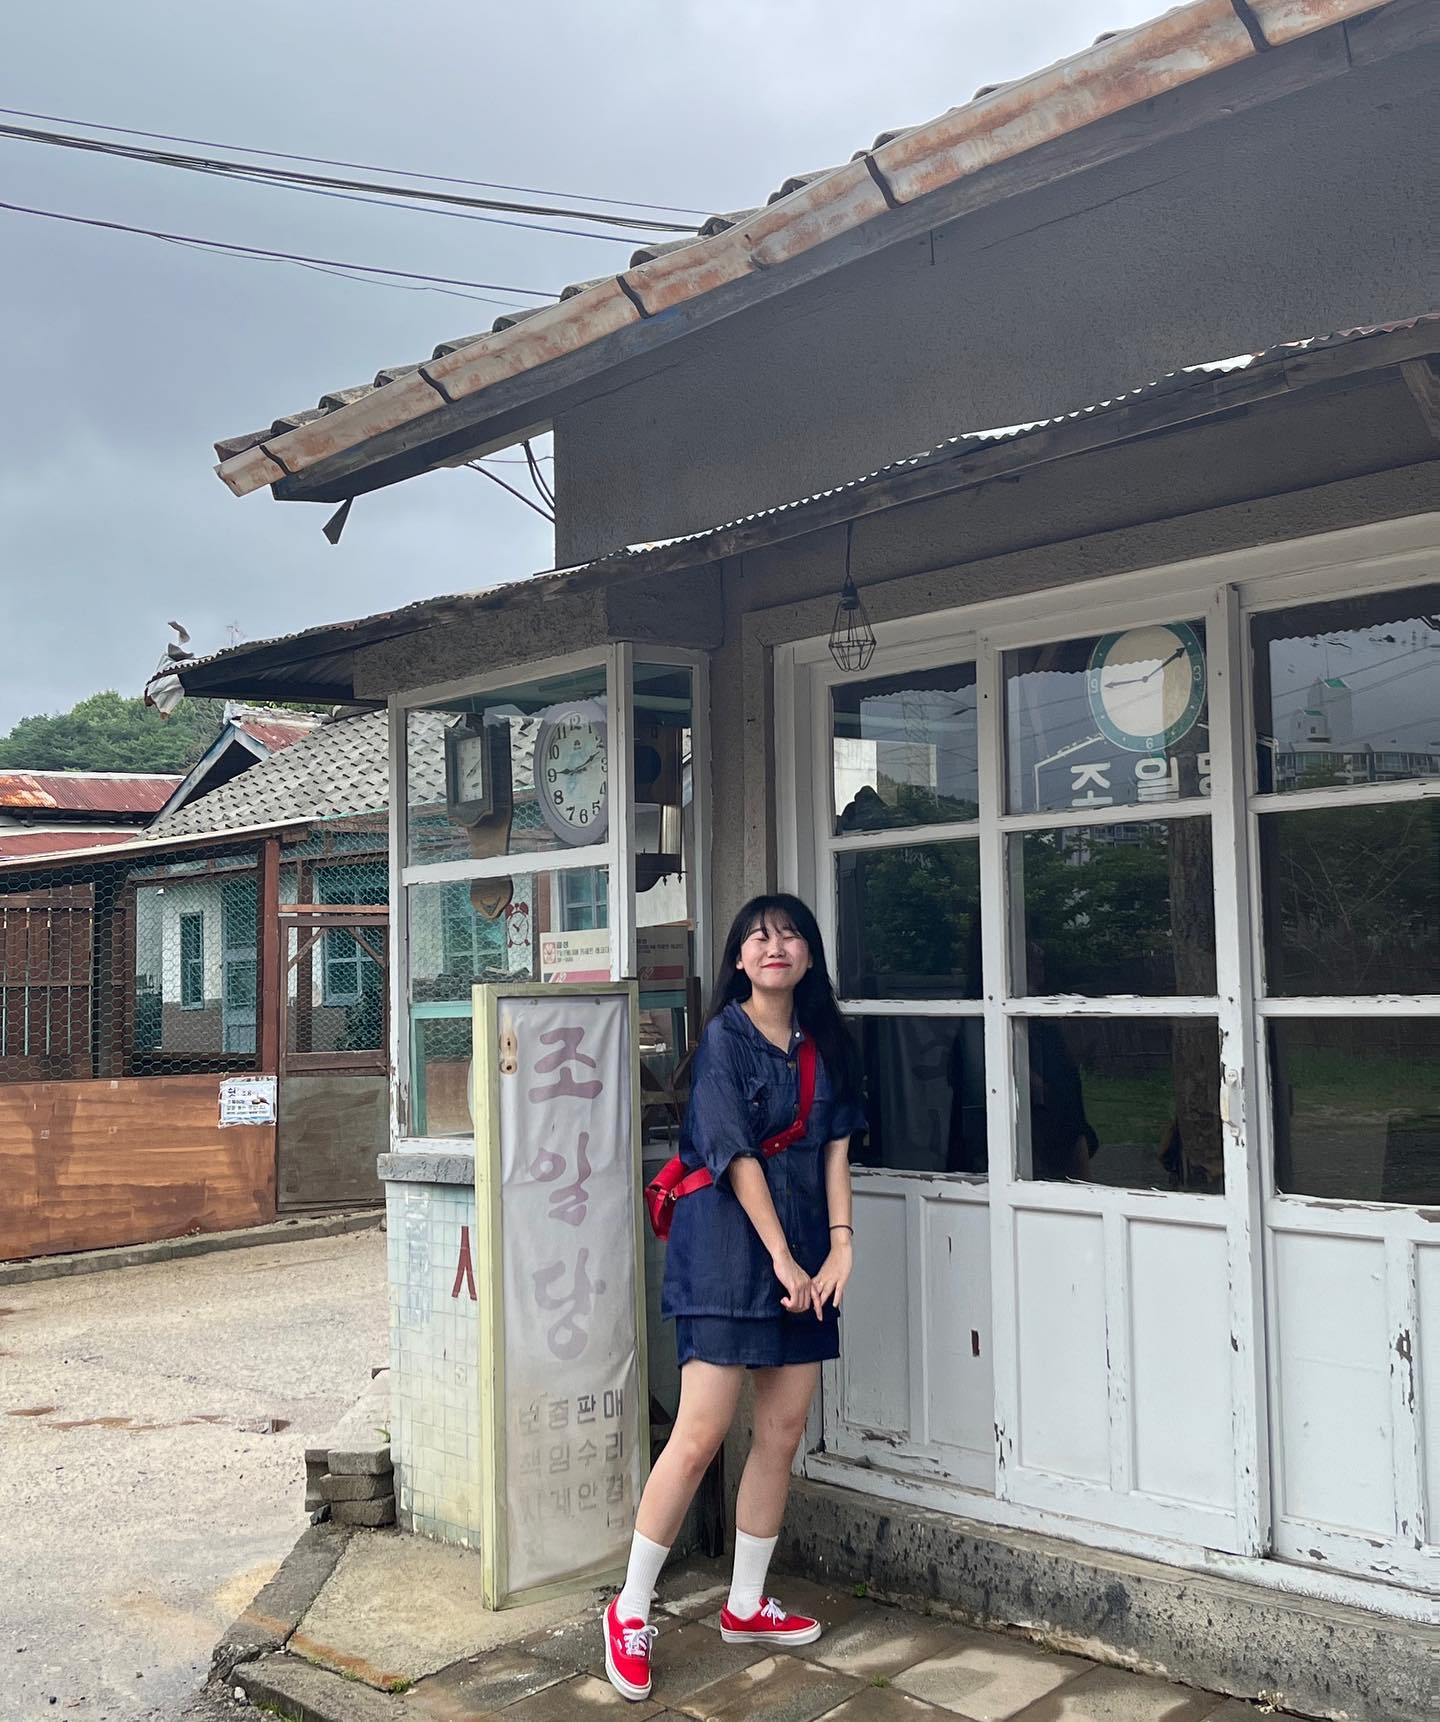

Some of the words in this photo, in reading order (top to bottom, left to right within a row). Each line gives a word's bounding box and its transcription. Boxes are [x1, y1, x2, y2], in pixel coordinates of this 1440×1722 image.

[1192, 665, 1201, 681] 3
[1090, 678, 1099, 694] 9
[569, 714, 582, 731] 12
[556, 725, 567, 740] 11
[595, 734, 604, 748] 2
[1145, 737, 1154, 749] 6
[549, 744, 560, 760] 10
[547, 767, 558, 783] 9
[553, 789, 564, 805] 8
[566, 806, 576, 821] 7
[592, 800, 601, 815] 5
[579, 808, 589, 824] 6
